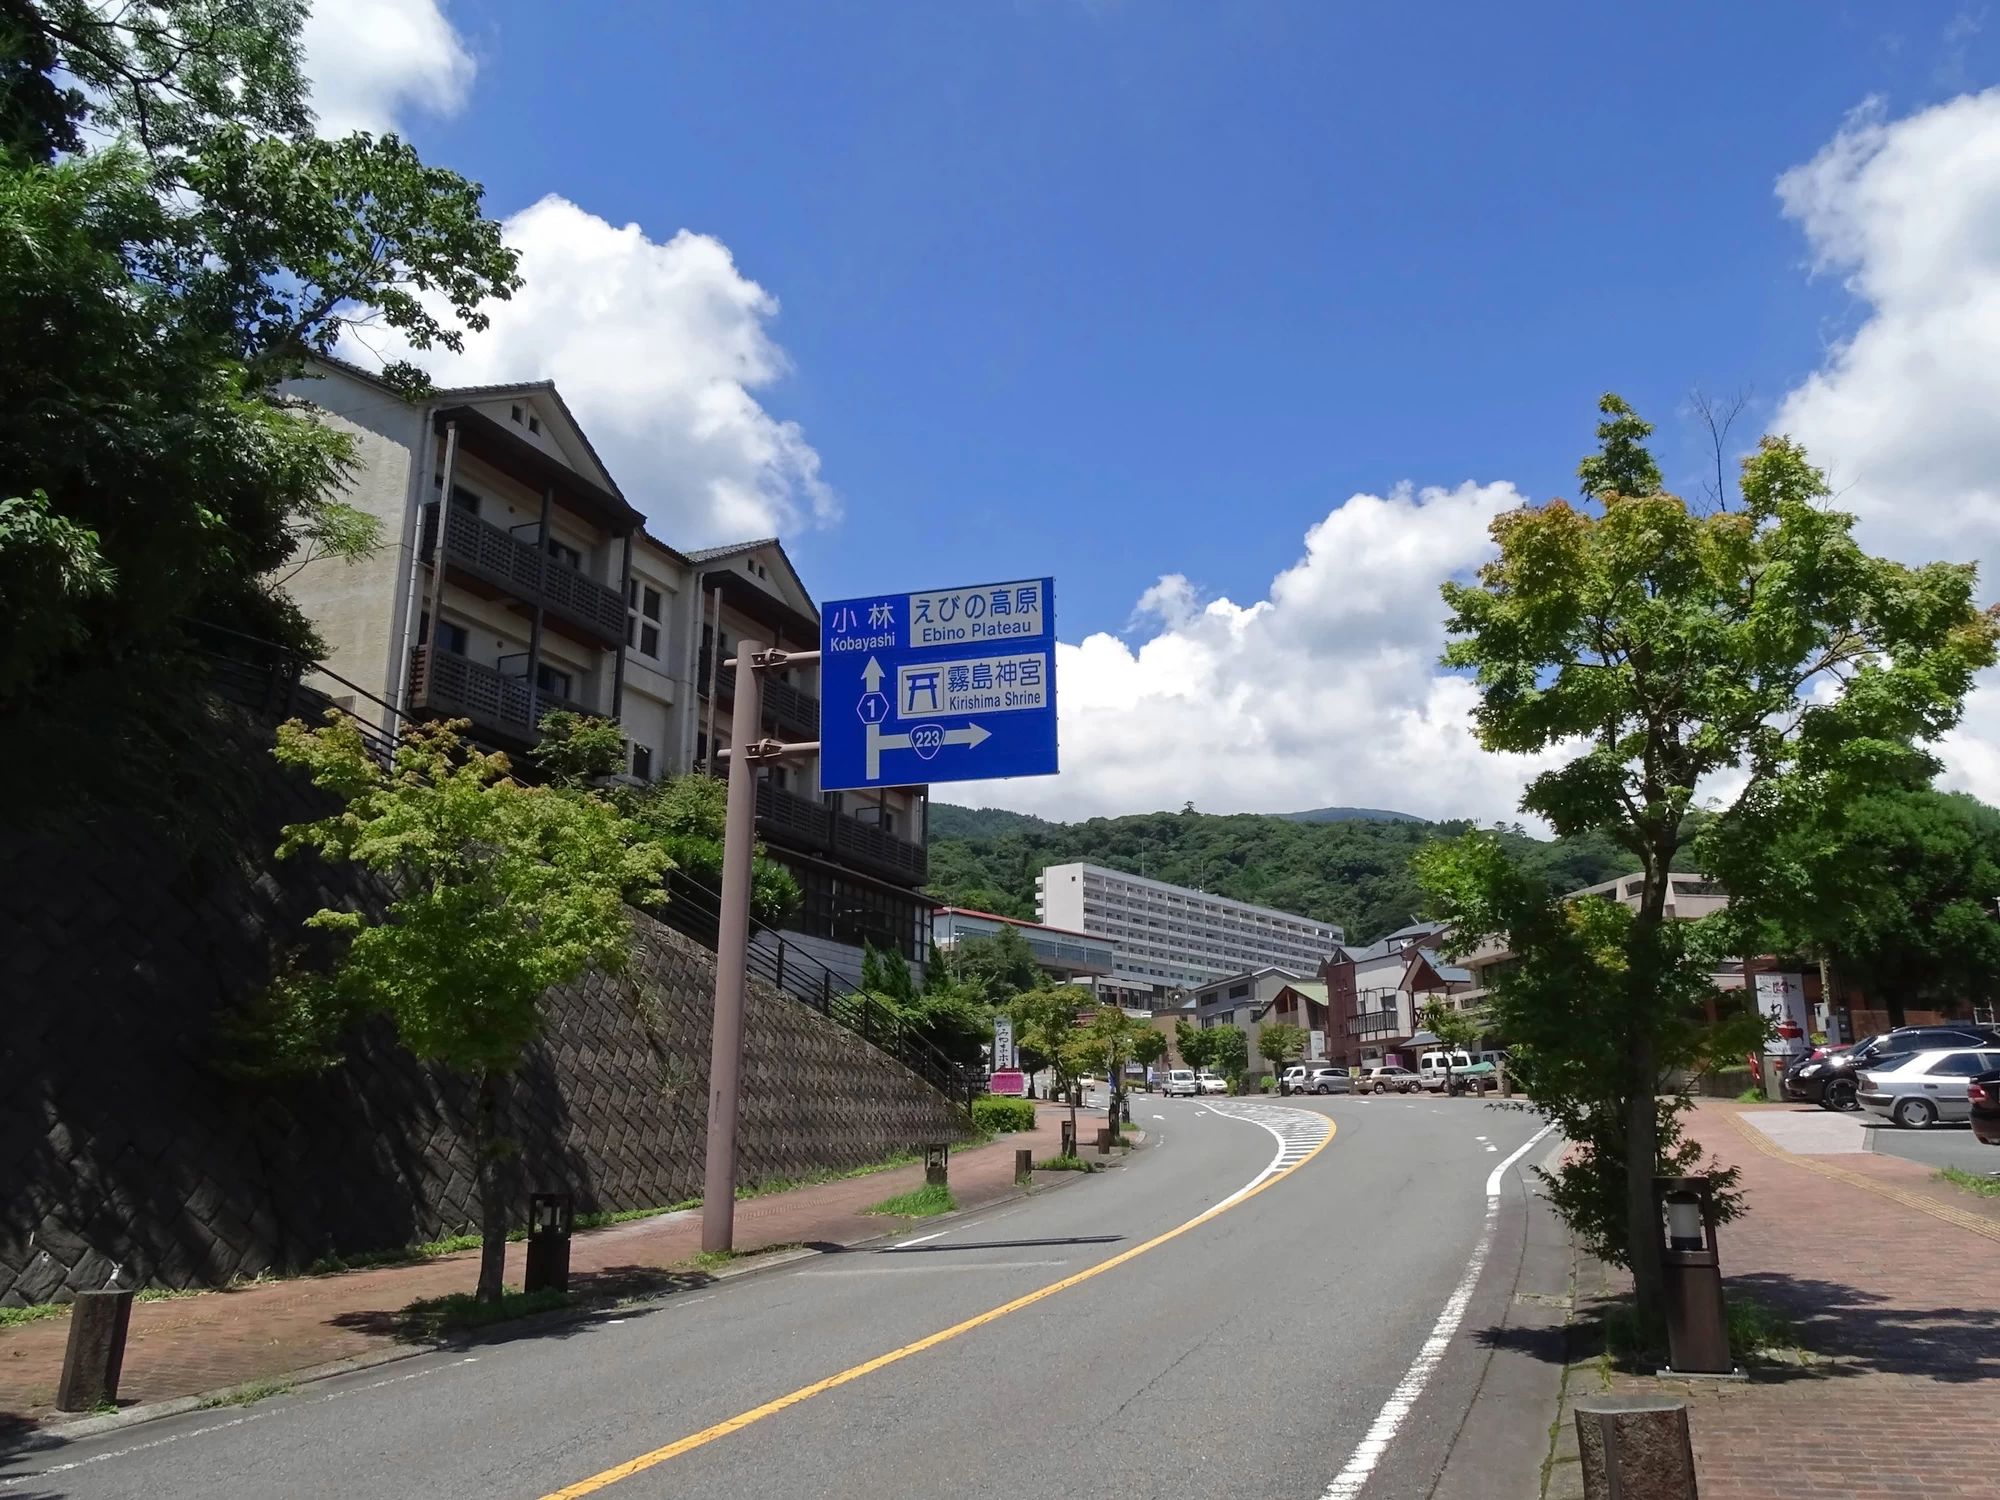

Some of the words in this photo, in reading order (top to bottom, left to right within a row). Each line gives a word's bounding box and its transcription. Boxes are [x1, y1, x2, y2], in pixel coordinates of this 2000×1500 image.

[914, 587, 1038, 625] えびの高原
[832, 603, 895, 633] 小林
[923, 626, 965, 642] Ebino
[972, 620, 1031, 637] Plateau
[831, 632, 895, 652] Kobayashi
[948, 659, 1041, 692] 霧島神宮
[867, 699, 875, 718] 1
[949, 695, 1000, 711] Kirishima
[1005, 692, 1041, 706] Shrine
[915, 731, 939, 746] 223
